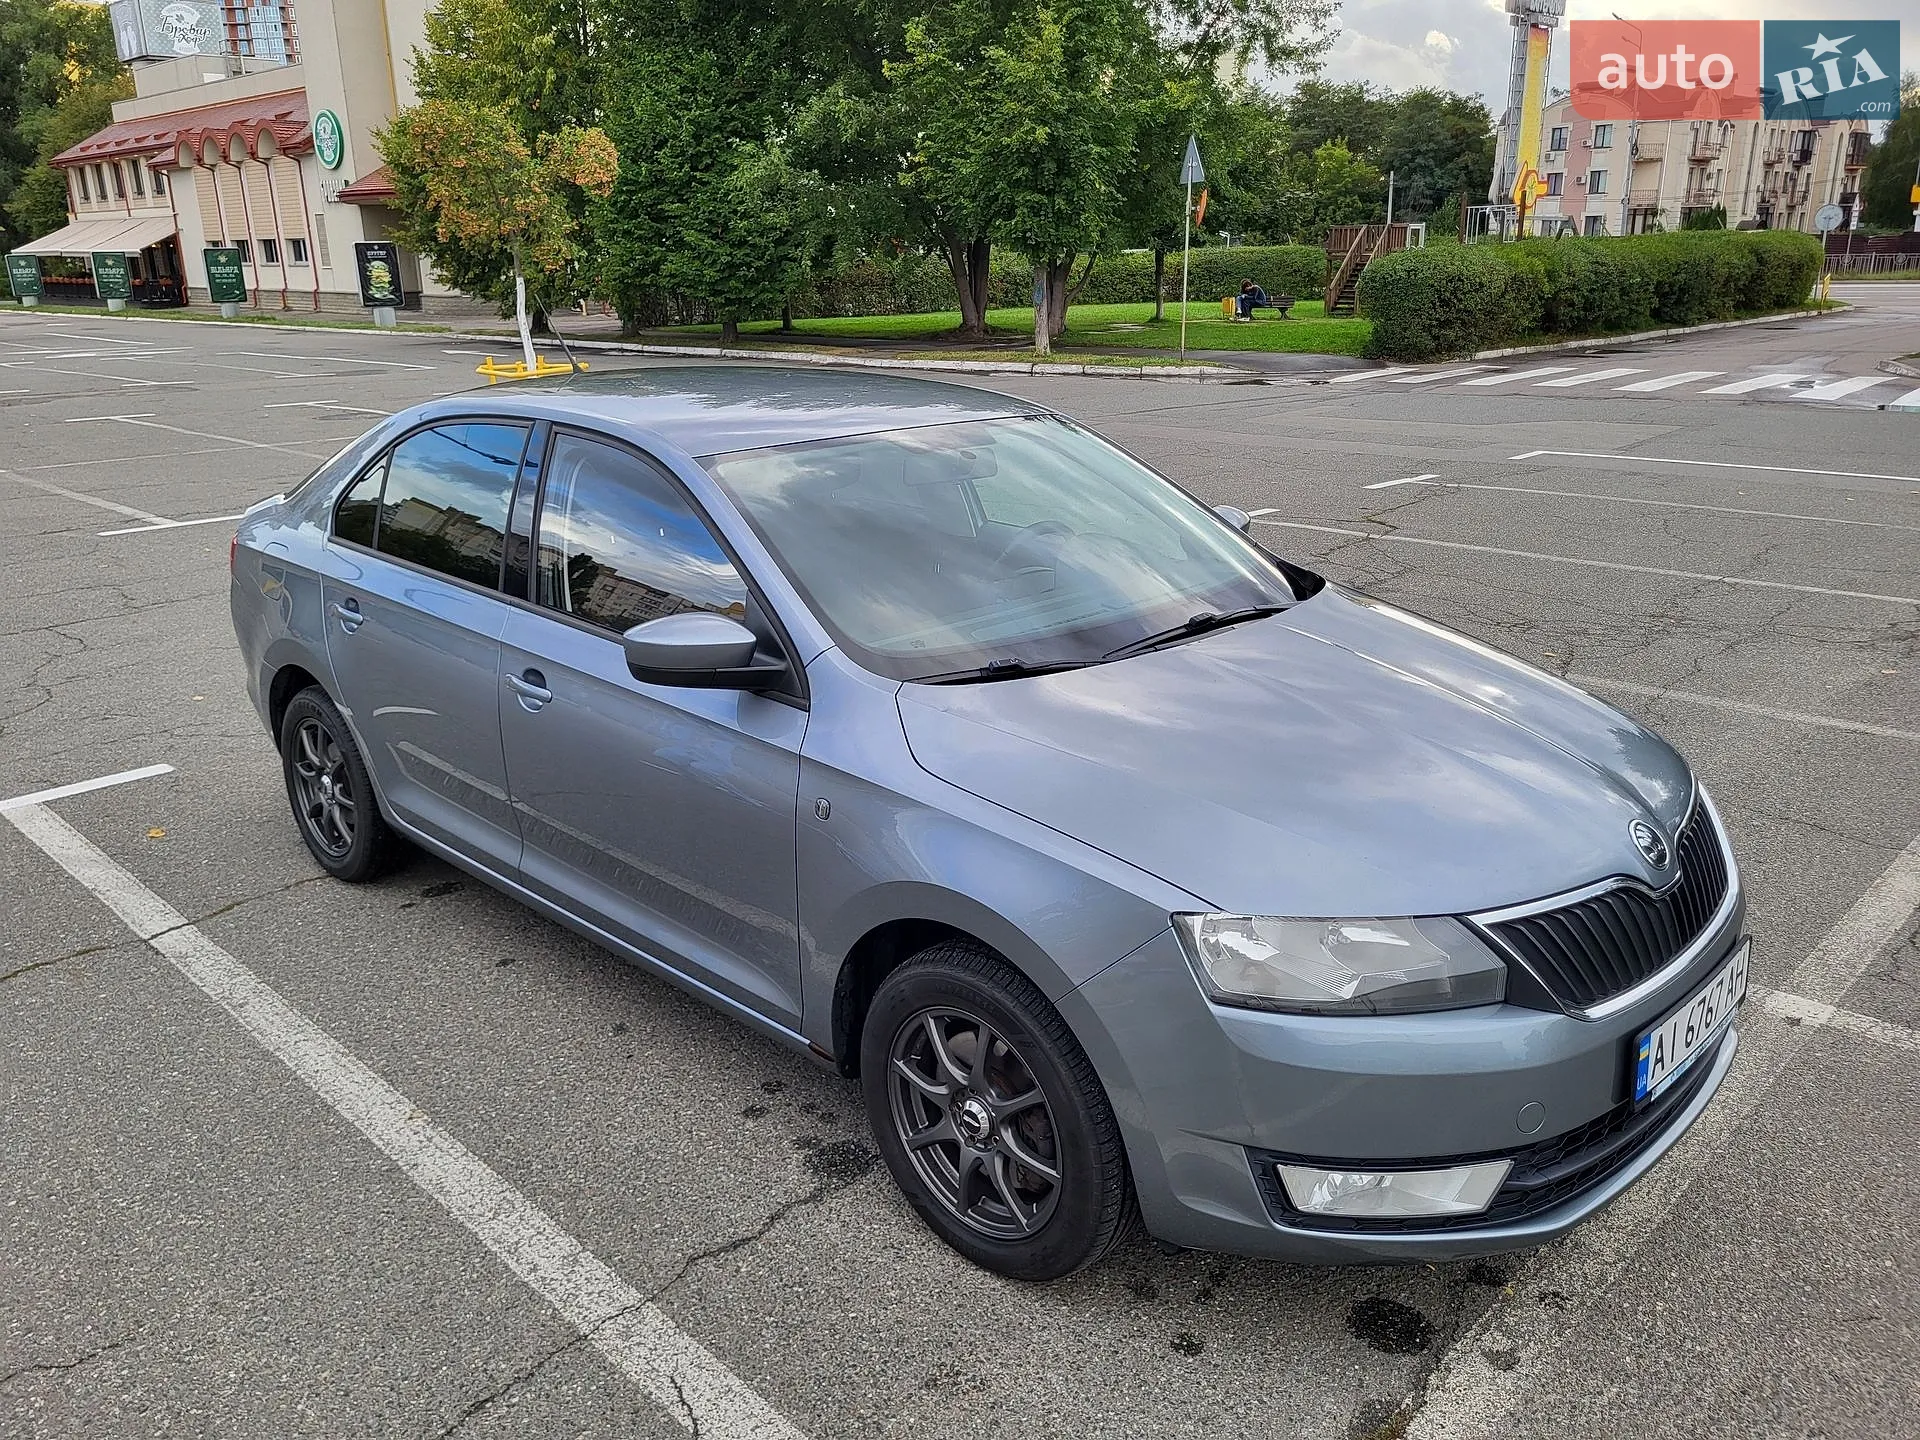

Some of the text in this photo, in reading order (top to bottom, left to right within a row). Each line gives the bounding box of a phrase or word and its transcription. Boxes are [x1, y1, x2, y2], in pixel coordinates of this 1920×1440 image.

[1651, 1022, 1678, 1080] AI
[1684, 977, 1725, 1049] 6767
[1725, 951, 1746, 1009] AH
[1637, 1077, 1648, 1091] UA
